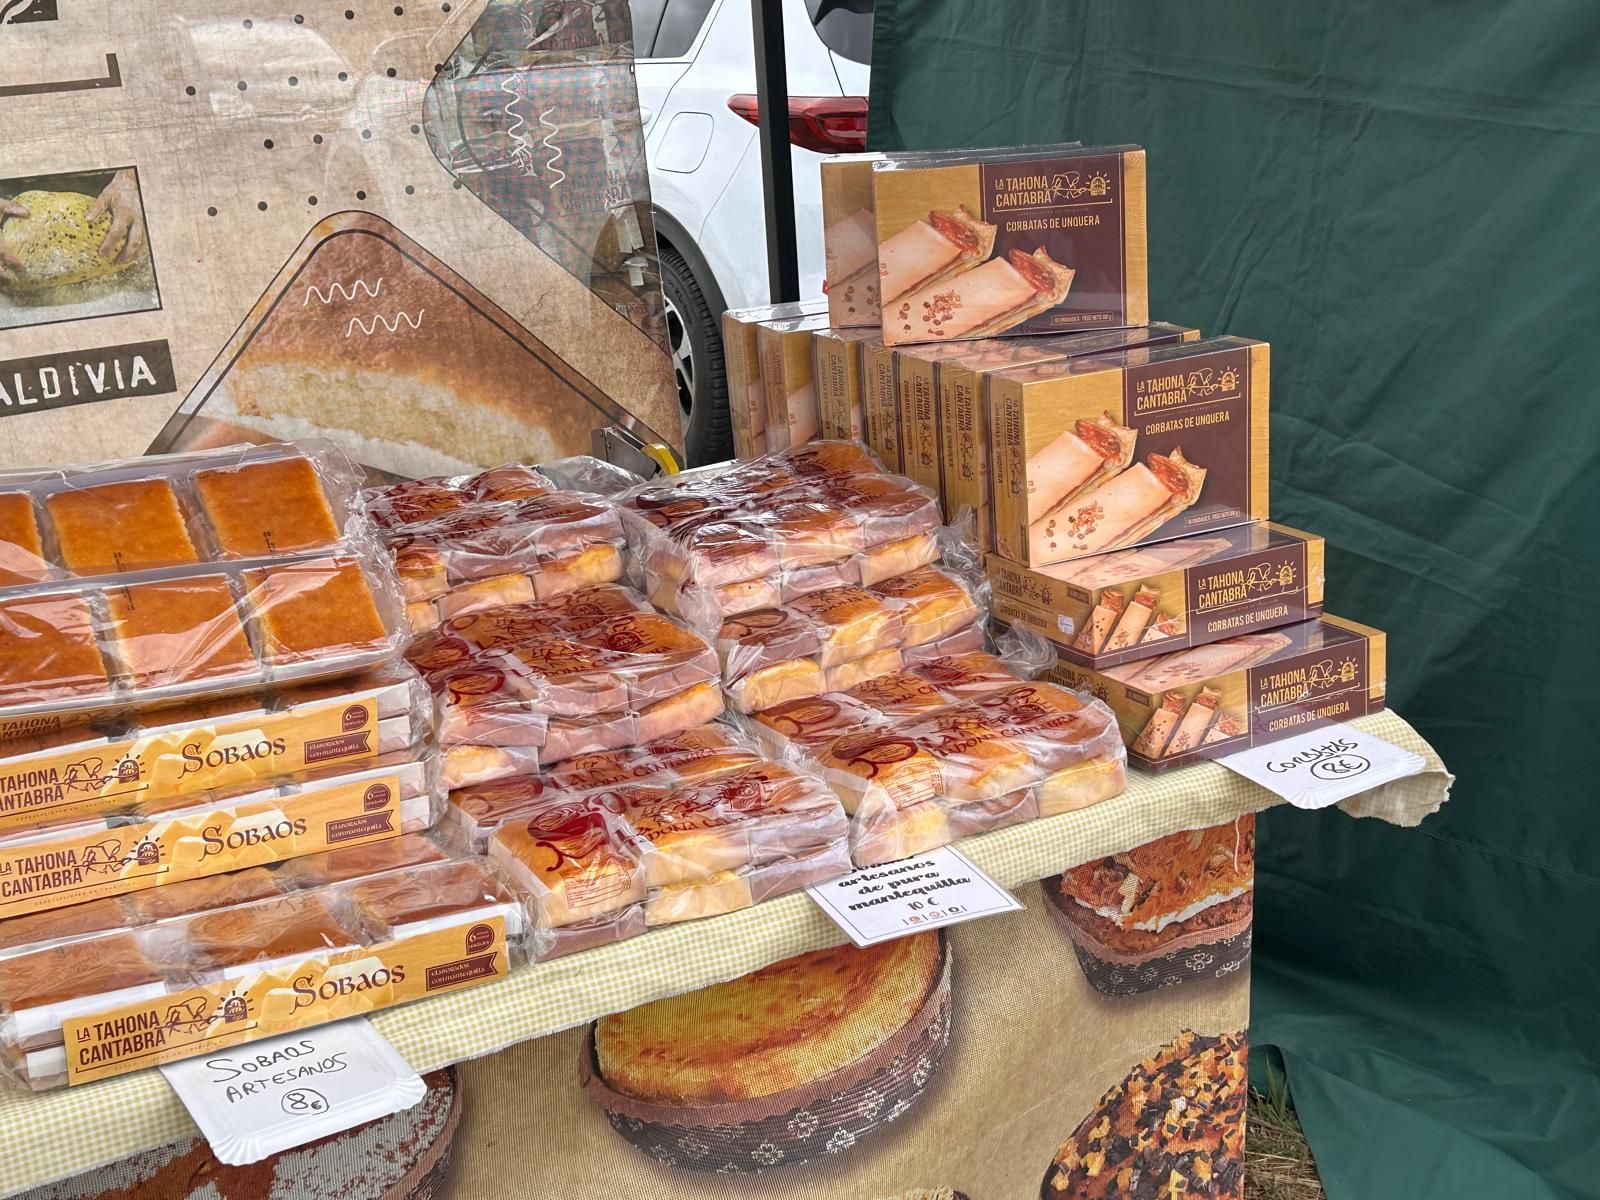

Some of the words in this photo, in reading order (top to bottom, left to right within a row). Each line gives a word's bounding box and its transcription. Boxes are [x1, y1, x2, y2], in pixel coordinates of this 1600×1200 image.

[995, 179, 1004, 188] LA
[1006, 175, 1049, 192] TAHONA
[996, 191, 1052, 208] CANTABRA
[1006, 218, 1048, 232] CORBATAS
[1049, 218, 1061, 229] DE
[1061, 215, 1100, 228] UNQUERA
[1136, 382, 1145, 391] LA
[1146, 374, 1185, 393] TAHONA
[956, 384, 965, 431] CANTABRA
[1136, 389, 1188, 411] CANTABRA
[964, 396, 972, 432] TAHONA
[1145, 420, 1183, 435] CORBATAS
[1184, 418, 1195, 429] DE
[1195, 411, 1230, 426] UNQUERA
[1198, 578, 1207, 589] LA
[1207, 570, 1245, 591] TAHONA
[1198, 586, 1247, 609] CANTABRA
[1207, 615, 1244, 633] CORBATAS
[1245, 613, 1254, 625] DE
[1254, 605, 1289, 624] UNQUERA
[1260, 678, 1269, 689] LA
[1269, 669, 1306, 689] TAHONA
[1260, 683, 1309, 707] CANTABRA
[345, 712, 352, 721] 6
[1269, 715, 1306, 732] CORBATAS
[1306, 712, 1316, 722] DE
[1316, 705, 1350, 720] UNQUERA
[178, 737, 287, 780] SOBAOS
[0, 768, 59, 794] TAHONA
[367, 791, 374, 800] 6
[199, 817, 307, 862] SOBAOS
[15, 849, 77, 876] TAHONA
[838, 860, 936, 888] artesanos
[2, 866, 83, 898] CANTABRA
[847, 877, 971, 911] mantequilla
[858, 883, 884, 895] de
[888, 871, 940, 890] pura
[907, 901, 924, 911] 10
[469, 932, 477, 942] 6
[289, 964, 406, 1015] SOBAOS
[76, 1026, 90, 1040] LA
[94, 1009, 161, 1041] TAHONA
[79, 1029, 167, 1066] CANTABRA
[206, 1040, 315, 1084] SOBAOS
[225, 1052, 350, 1103] ARTESANOS
